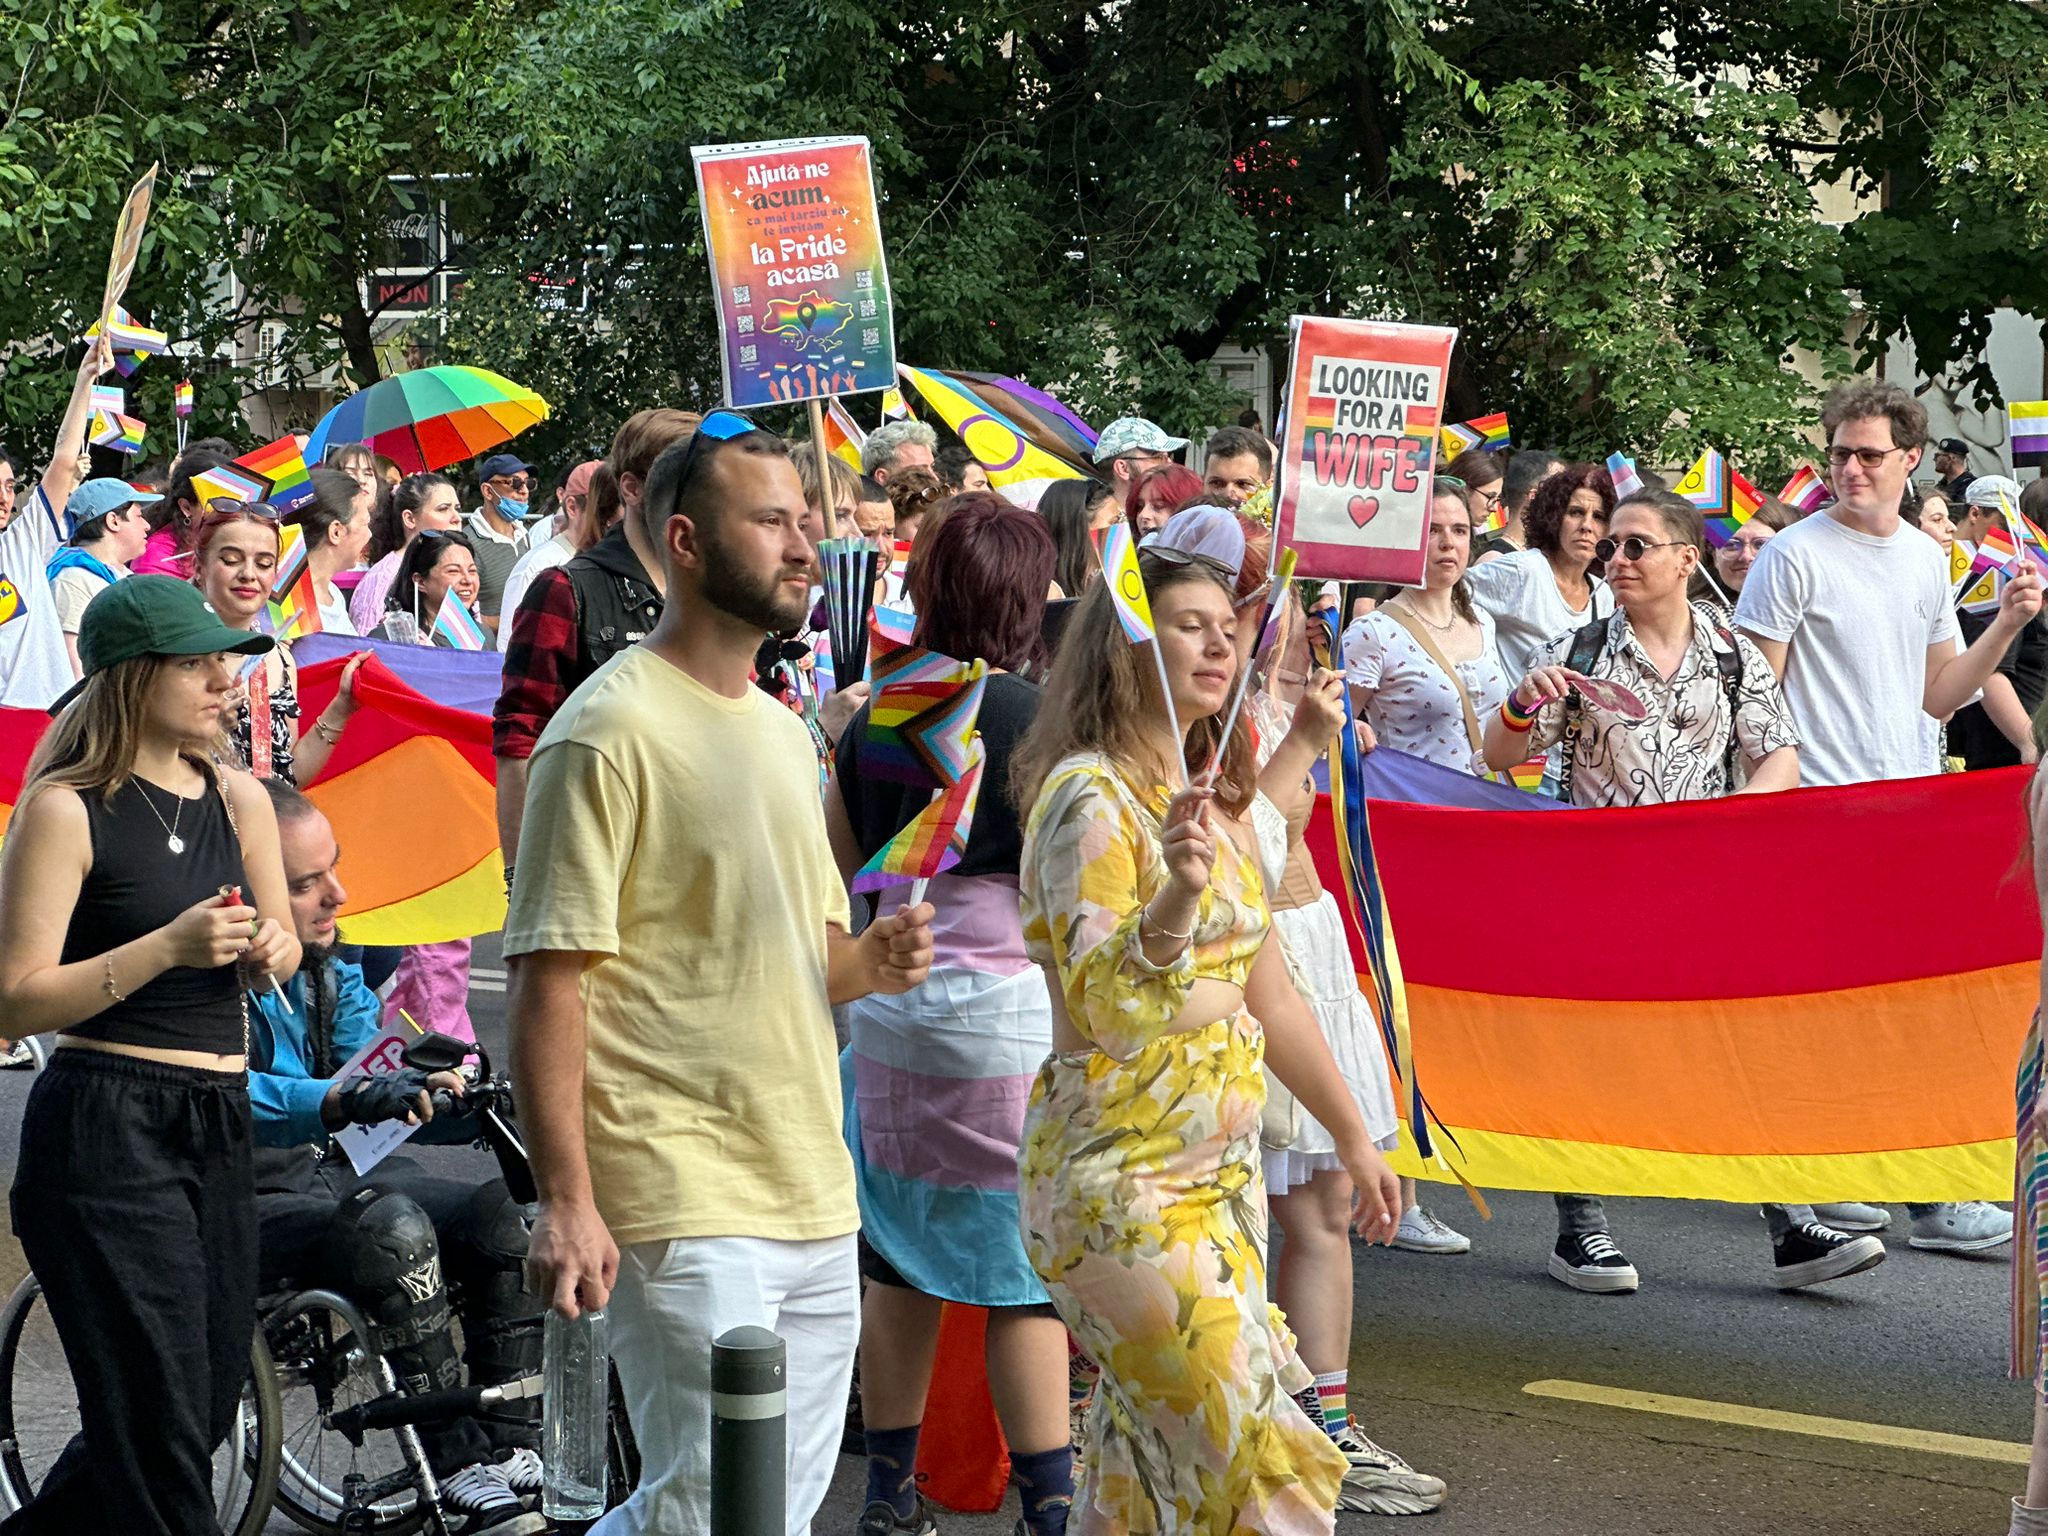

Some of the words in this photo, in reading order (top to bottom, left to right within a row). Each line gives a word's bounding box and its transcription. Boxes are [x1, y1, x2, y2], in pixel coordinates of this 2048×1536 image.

[747, 162, 830, 189] Ajută-ne
[750, 242, 775, 265] la
[779, 233, 847, 261] Pride
[767, 259, 840, 287] acasă
[1318, 364, 1430, 402] LOOKING
[1337, 399, 1382, 430] FOR
[1387, 405, 1404, 431] A
[1313, 429, 1422, 493] WIFE
[1300, 1387, 1327, 1434] RAINB
